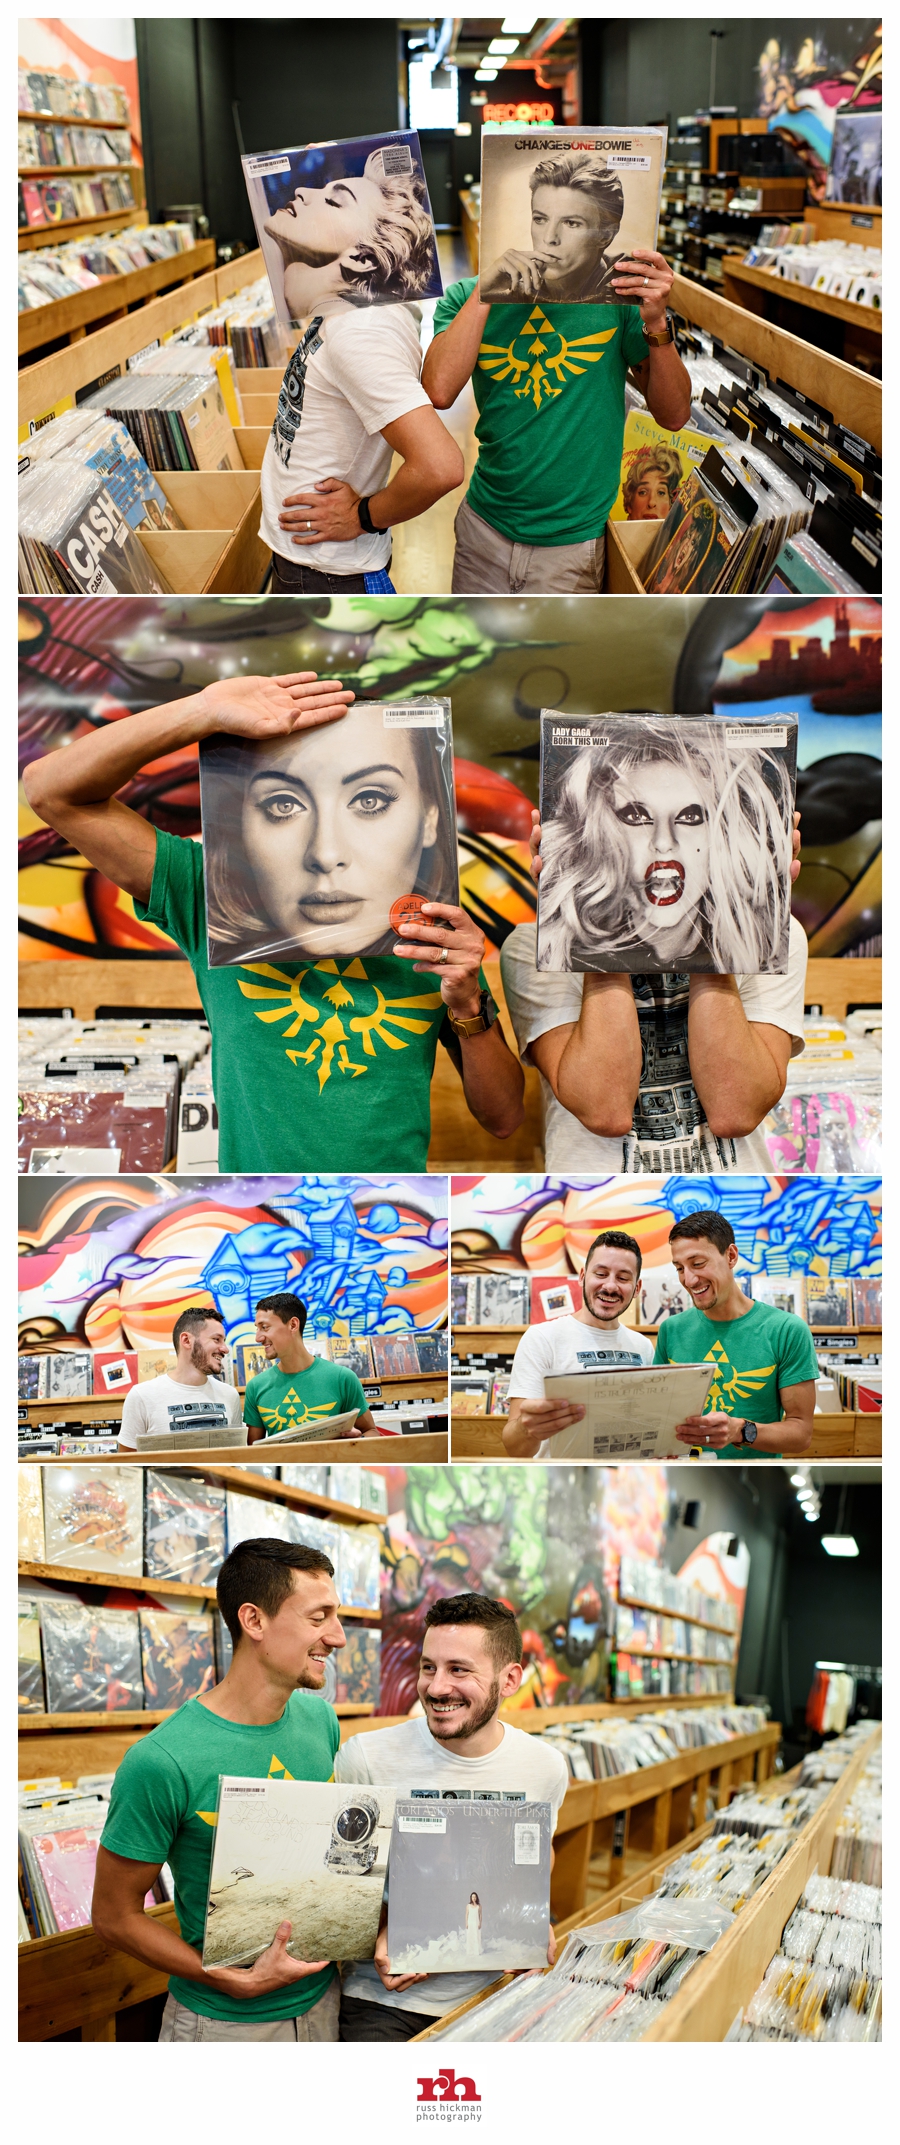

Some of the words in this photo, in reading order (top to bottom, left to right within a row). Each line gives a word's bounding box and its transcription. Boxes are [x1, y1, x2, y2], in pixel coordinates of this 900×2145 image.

[483, 102, 554, 121] RECORD
[485, 140, 632, 151] CHANGESONEBOWIE
[633, 420, 665, 442] Steve
[67, 488, 122, 579] CASH
[90, 569, 105, 593] CASH
[552, 728, 570, 736] LADY
[571, 728, 591, 736] GAGA
[553, 737, 573, 745] BORN
[592, 738, 608, 746] WAY
[827, 1336, 854, 1348] Singles
[463, 1806, 500, 1817] UNDER
[525, 1808, 550, 1818] PINK
